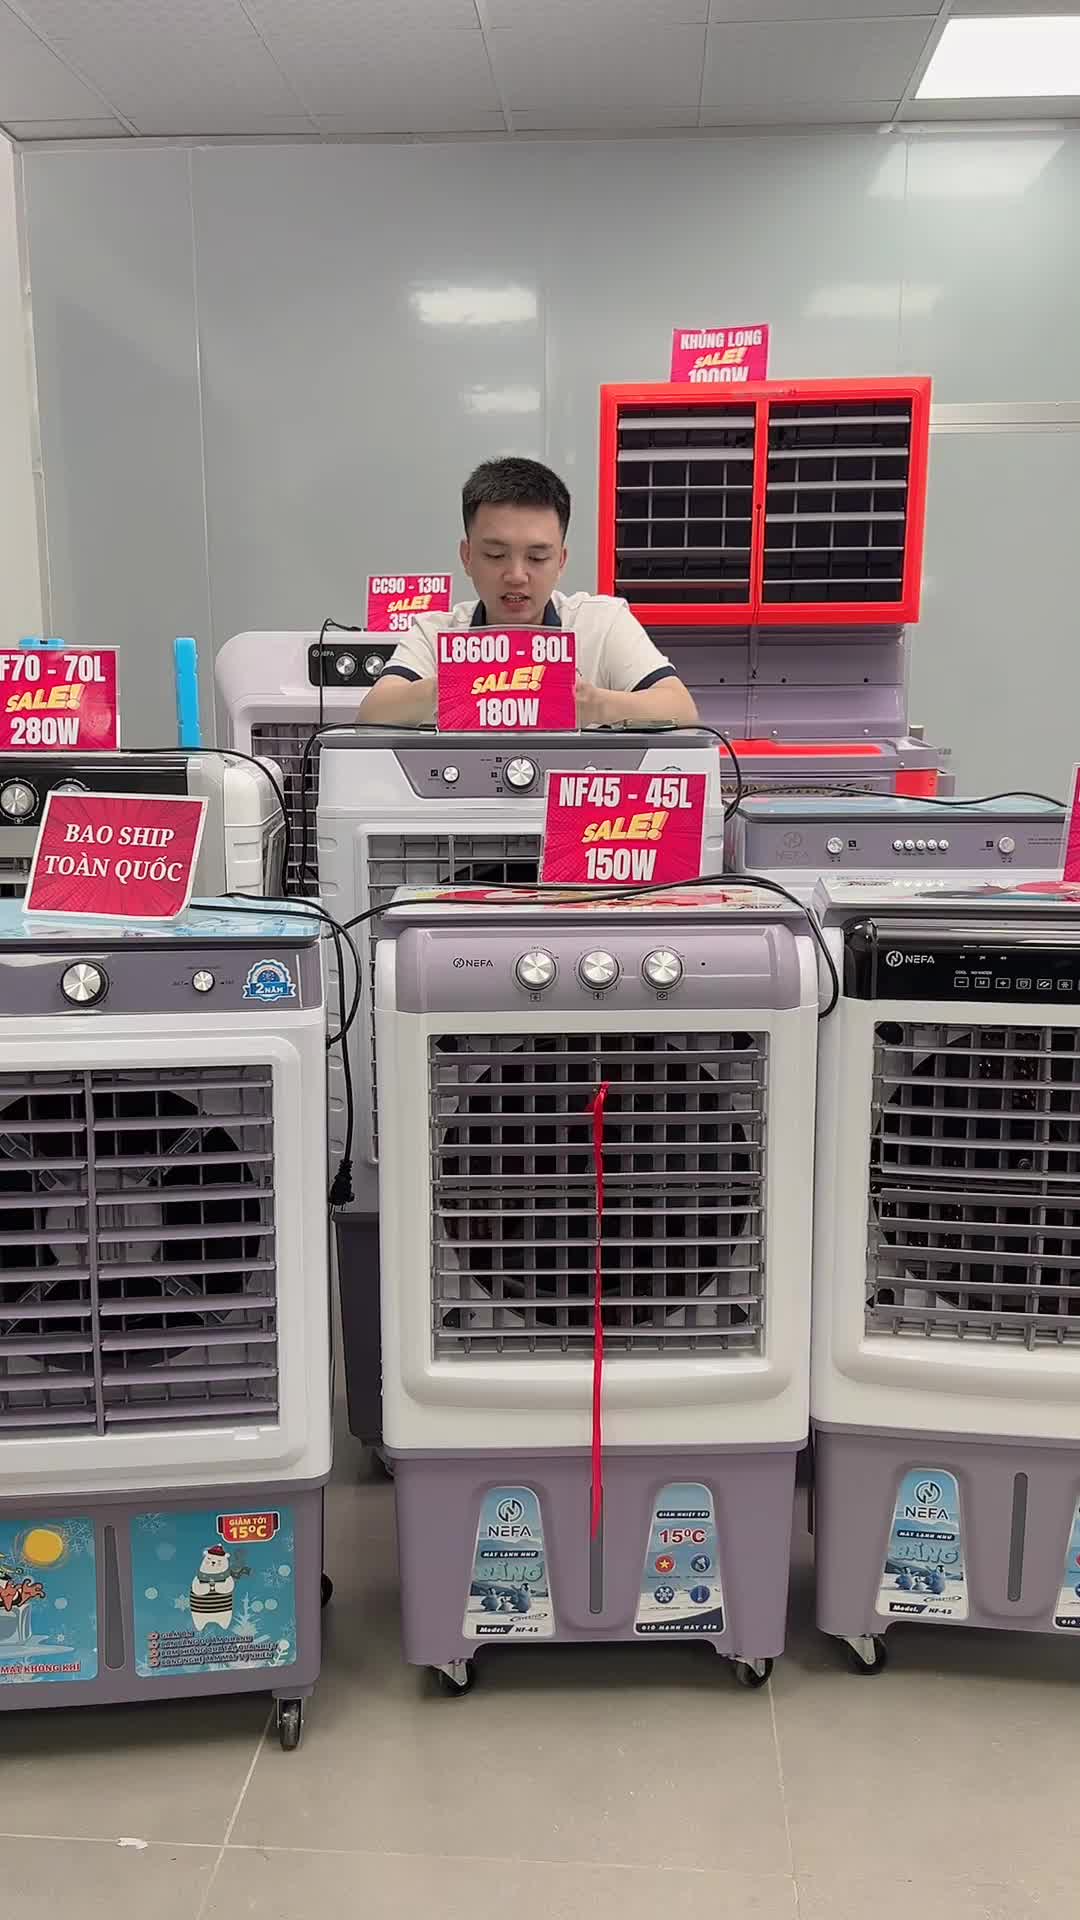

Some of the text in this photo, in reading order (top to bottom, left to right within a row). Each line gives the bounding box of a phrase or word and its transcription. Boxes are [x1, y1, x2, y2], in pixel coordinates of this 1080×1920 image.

[728, 329, 763, 347] LONG
[692, 347, 748, 369] SALE!
[688, 366, 749, 383] 1000W
[372, 577, 405, 594] CC90
[418, 577, 447, 593] 130L
[387, 594, 432, 613] SALE!
[440, 635, 510, 663] L8600
[531, 635, 573, 663] 80L
[63, 655, 106, 682] 70L
[471, 665, 547, 695] SALE!
[4, 683, 86, 713] SALE!
[476, 698, 540, 726] 180W
[10, 716, 80, 745] 280W
[558, 777, 621, 807] NF45
[645, 778, 692, 808] 45L
[64, 823, 175, 848] BAO SHIP
[581, 811, 670, 843] SALE!
[44, 852, 184, 885] TOÀN QUỐC
[584, 848, 657, 881] 150W
[465, 959, 494, 968] NEFA
[905, 955, 936, 964] NEFA
[229, 1516, 267, 1526] GIẢM TỚI
[905, 1506, 949, 1520] NEFA
[488, 1525, 532, 1537] NEFA
[895, 1542, 958, 1564] BĂNG
[479, 1561, 543, 1582] BĂNG
[928, 1607, 953, 1615] NF-45
